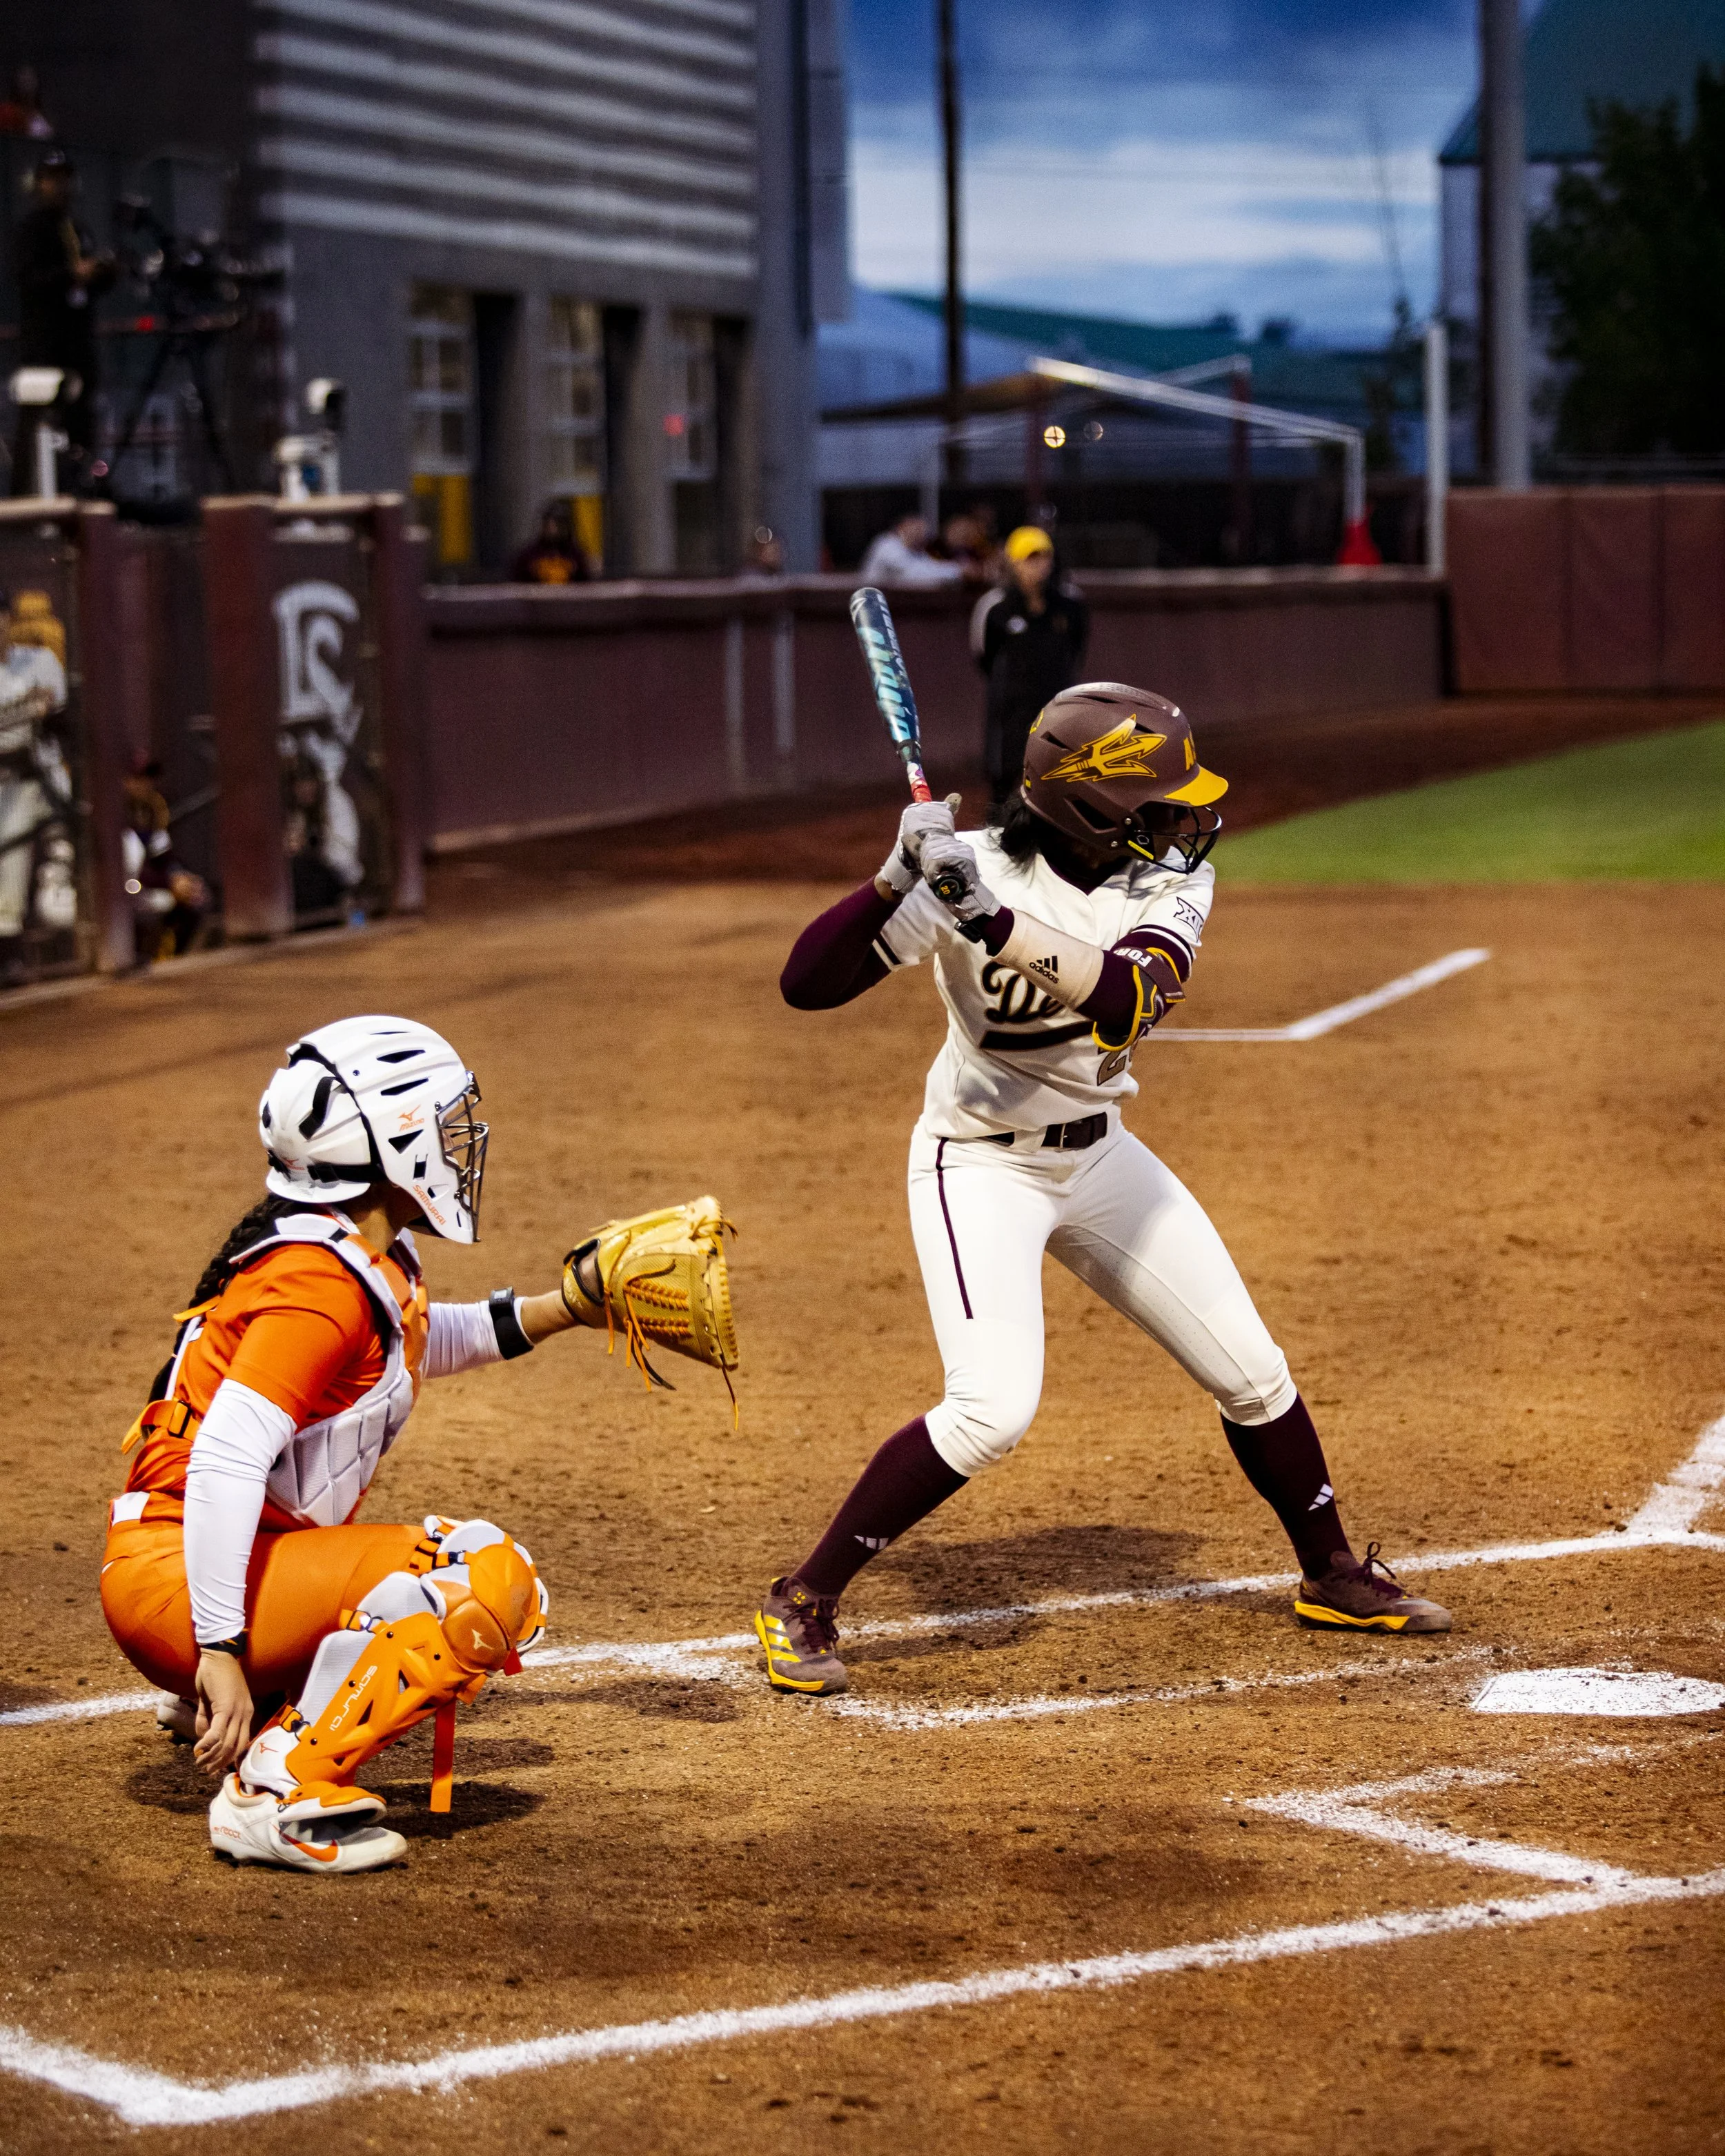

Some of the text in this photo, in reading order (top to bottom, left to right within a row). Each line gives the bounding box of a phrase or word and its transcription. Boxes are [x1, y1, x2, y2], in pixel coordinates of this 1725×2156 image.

[940, 885, 951, 895] 20
[1029, 962, 1059, 984] adidas
[413, 1185, 446, 1225] SAMURAI
